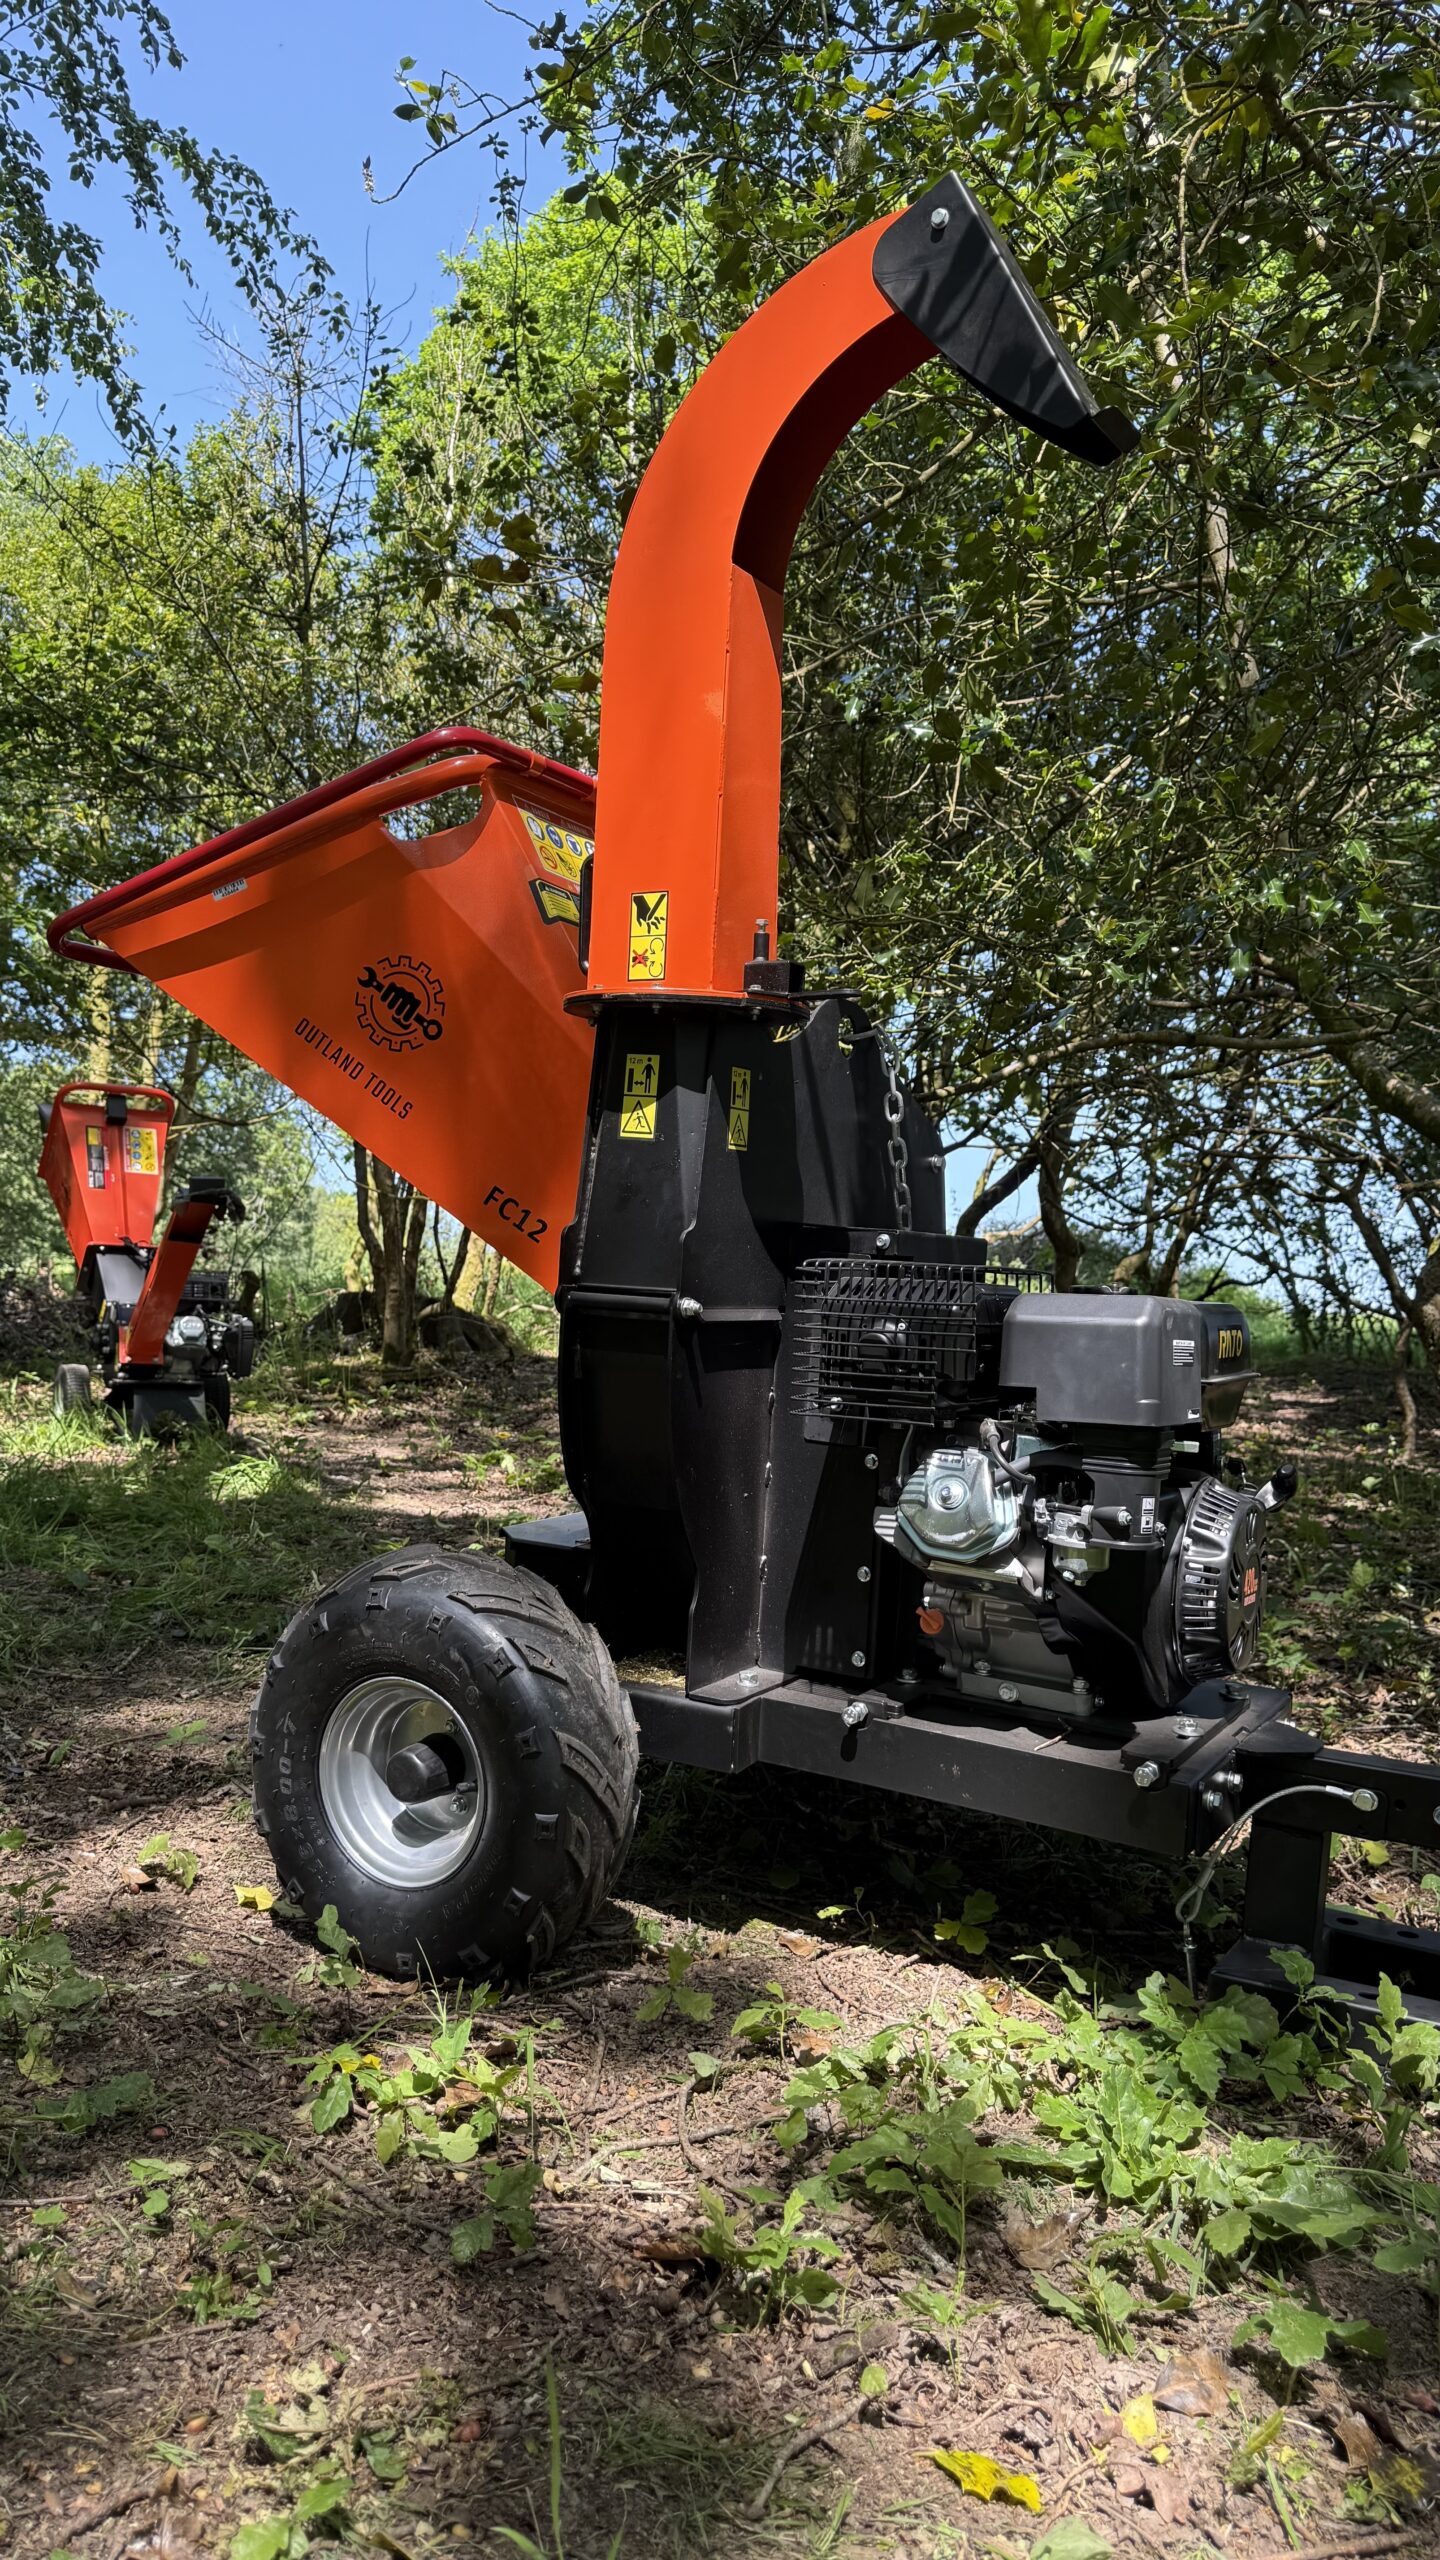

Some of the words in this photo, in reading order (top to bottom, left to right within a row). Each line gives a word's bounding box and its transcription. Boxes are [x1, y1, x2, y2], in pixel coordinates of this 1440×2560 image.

[295, 1018, 365, 1080] OUTLAND
[364, 1072, 414, 1119] TOOLS
[483, 1185, 548, 1244] FC12
[1218, 1329, 1243, 1359] RATO
